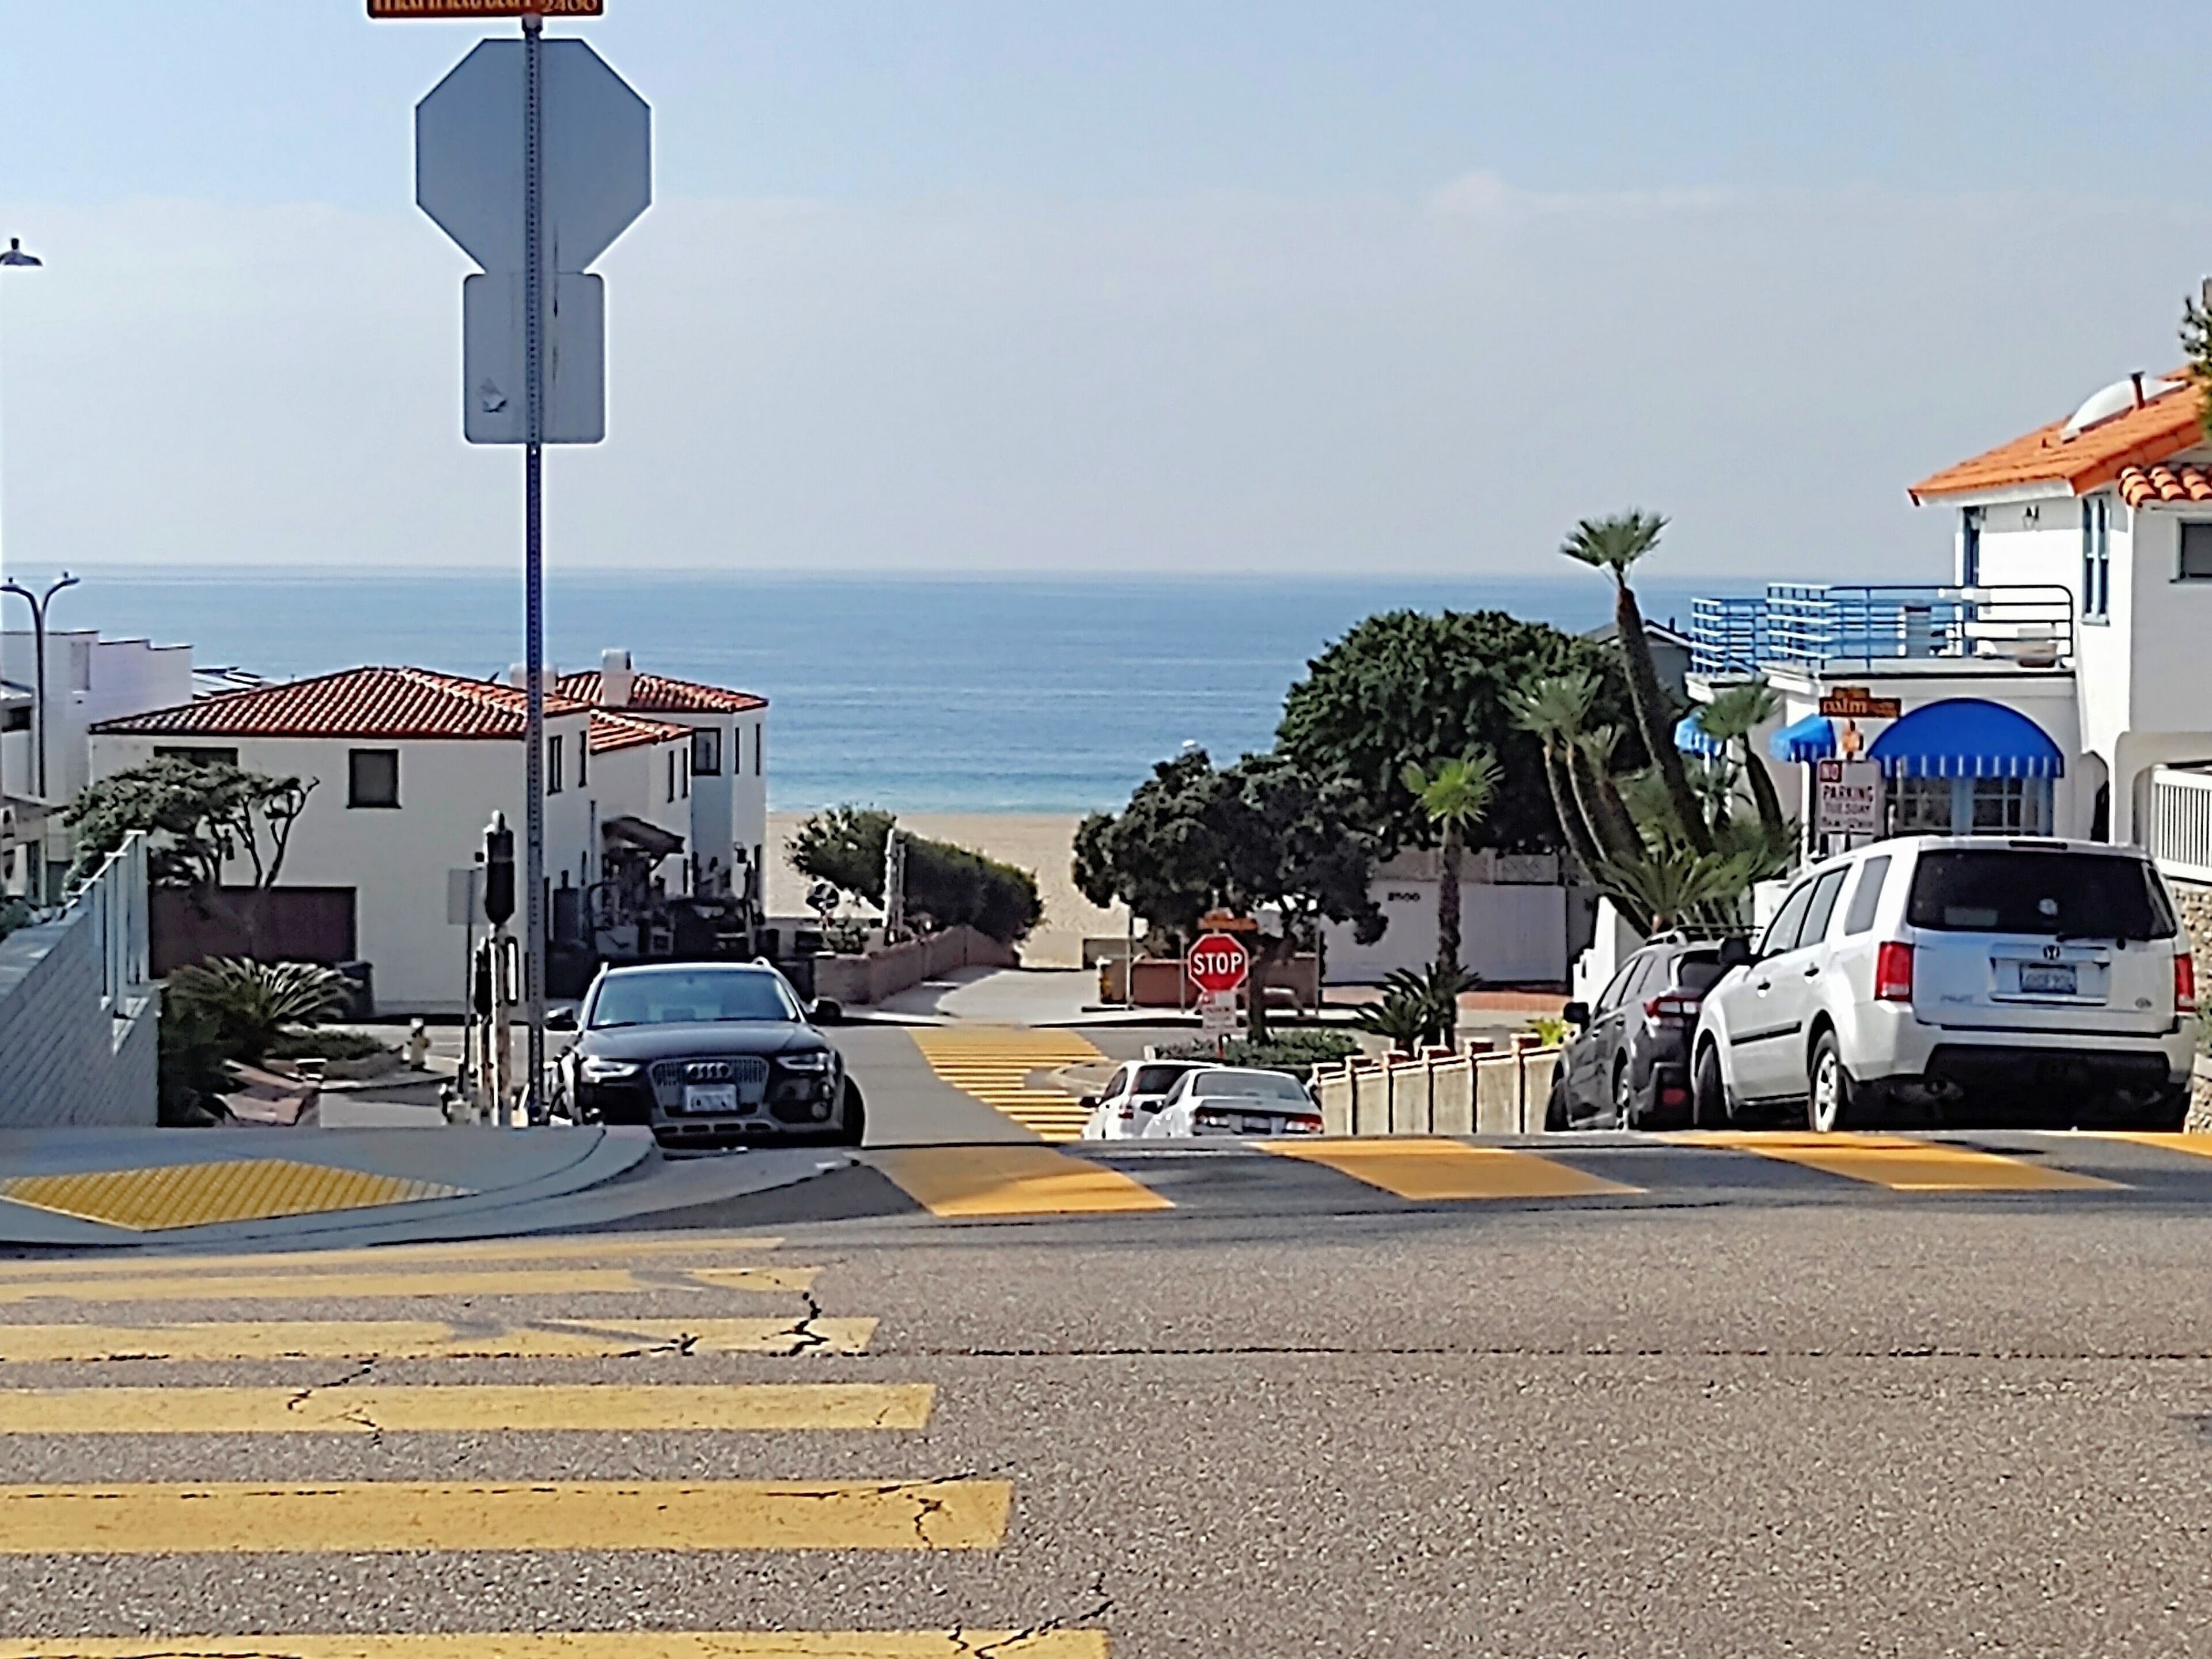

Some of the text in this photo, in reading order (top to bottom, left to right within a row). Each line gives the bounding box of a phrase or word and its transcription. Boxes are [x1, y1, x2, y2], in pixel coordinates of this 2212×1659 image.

[1821, 763, 1839, 780] NO
[1824, 786, 1873, 802] PARKING
[1193, 952, 1243, 975] STOP
